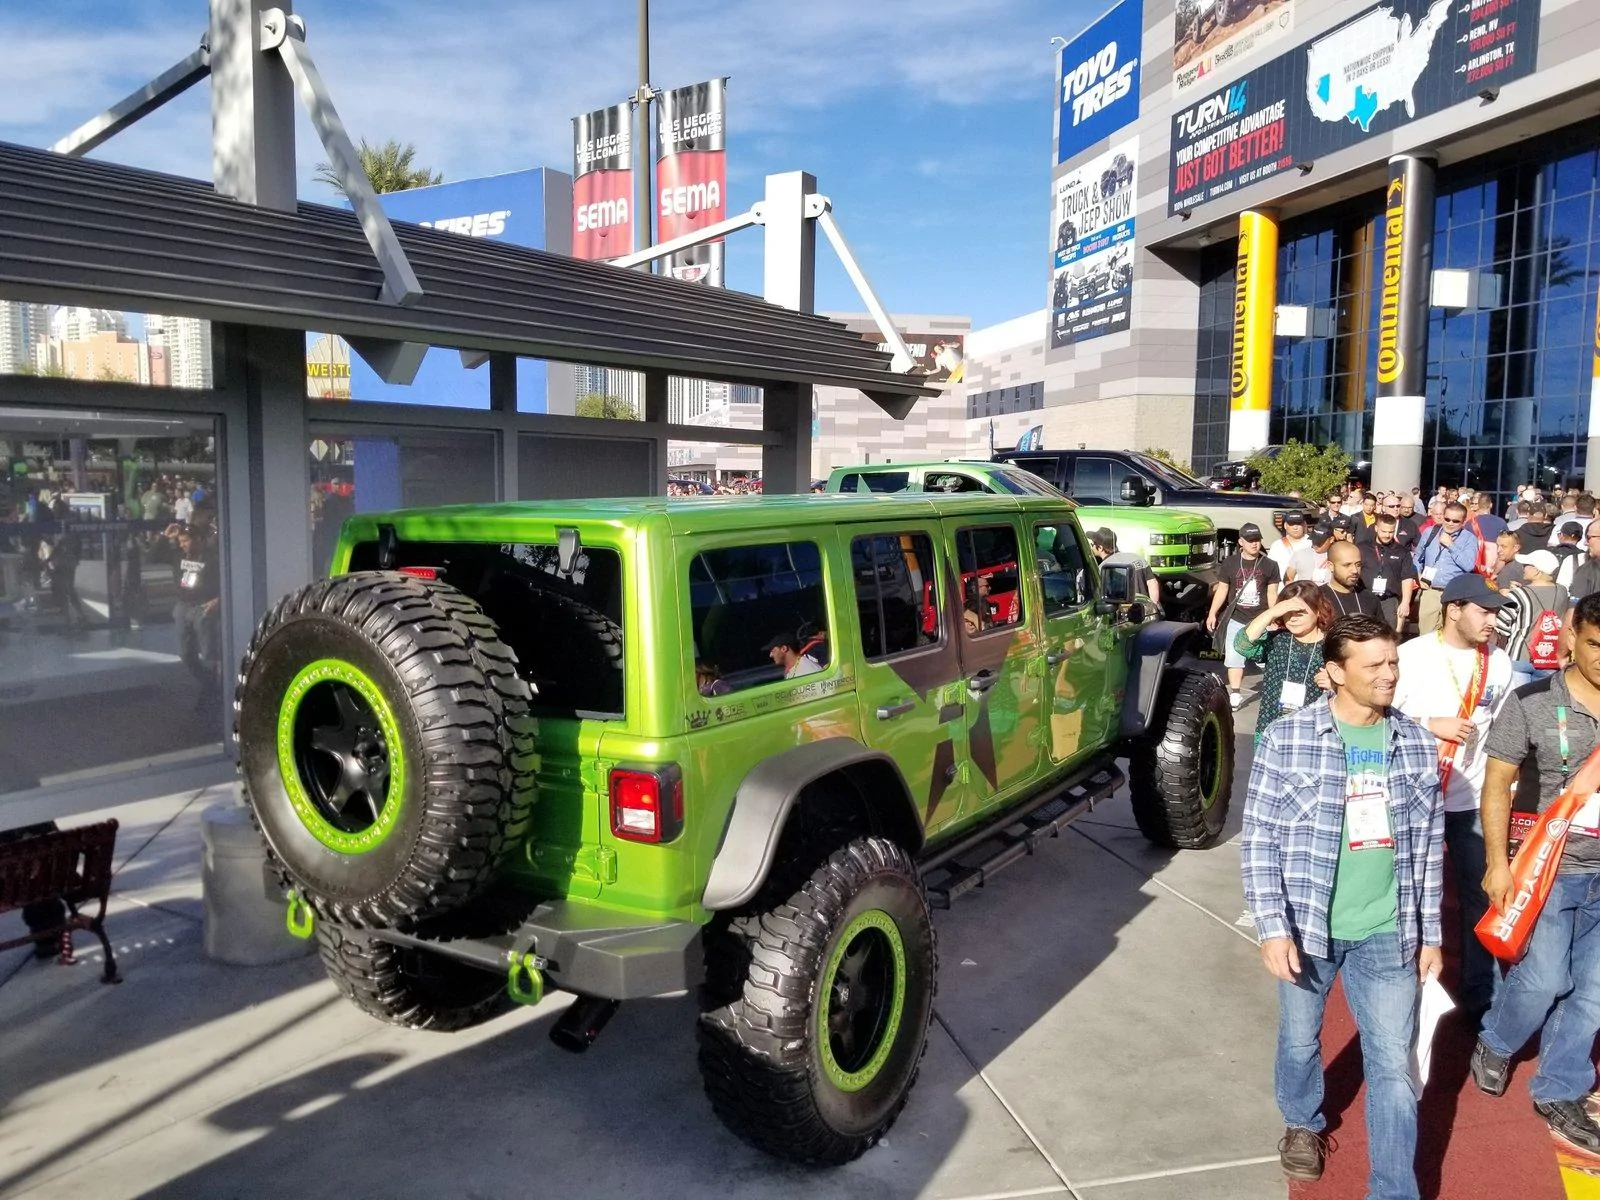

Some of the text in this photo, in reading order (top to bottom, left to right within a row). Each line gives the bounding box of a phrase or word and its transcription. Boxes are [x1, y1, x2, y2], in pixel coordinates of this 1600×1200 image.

[1063, 41, 1118, 103] TOYO
[1468, 41, 1515, 71] ARLINGTON, TX
[1072, 60, 1134, 127] TIRES
[659, 110, 722, 134] LAS VEGAS
[659, 122, 722, 144] WELCOMES
[1176, 99, 1286, 167] YOUR COMPETITIVE ADVANTAGE
[576, 130, 630, 154] LAS VEGAS
[576, 143, 630, 164] WELCOMES
[1174, 119, 1285, 194] JUST GOT BETTER!
[1238, 172, 1250, 185] VISIT
[1249, 170, 1257, 181] US
[1256, 167, 1263, 178] AT
[1262, 161, 1277, 176] BOOTH
[577, 197, 628, 232] SEMA
[661, 180, 721, 216] SEMA
[1061, 181, 1100, 219] TRUCK &
[1078, 190, 1132, 236] JEEP SHOW
[434, 210, 506, 238] TIRES
[1494, 841, 1553, 942] SPYDER
